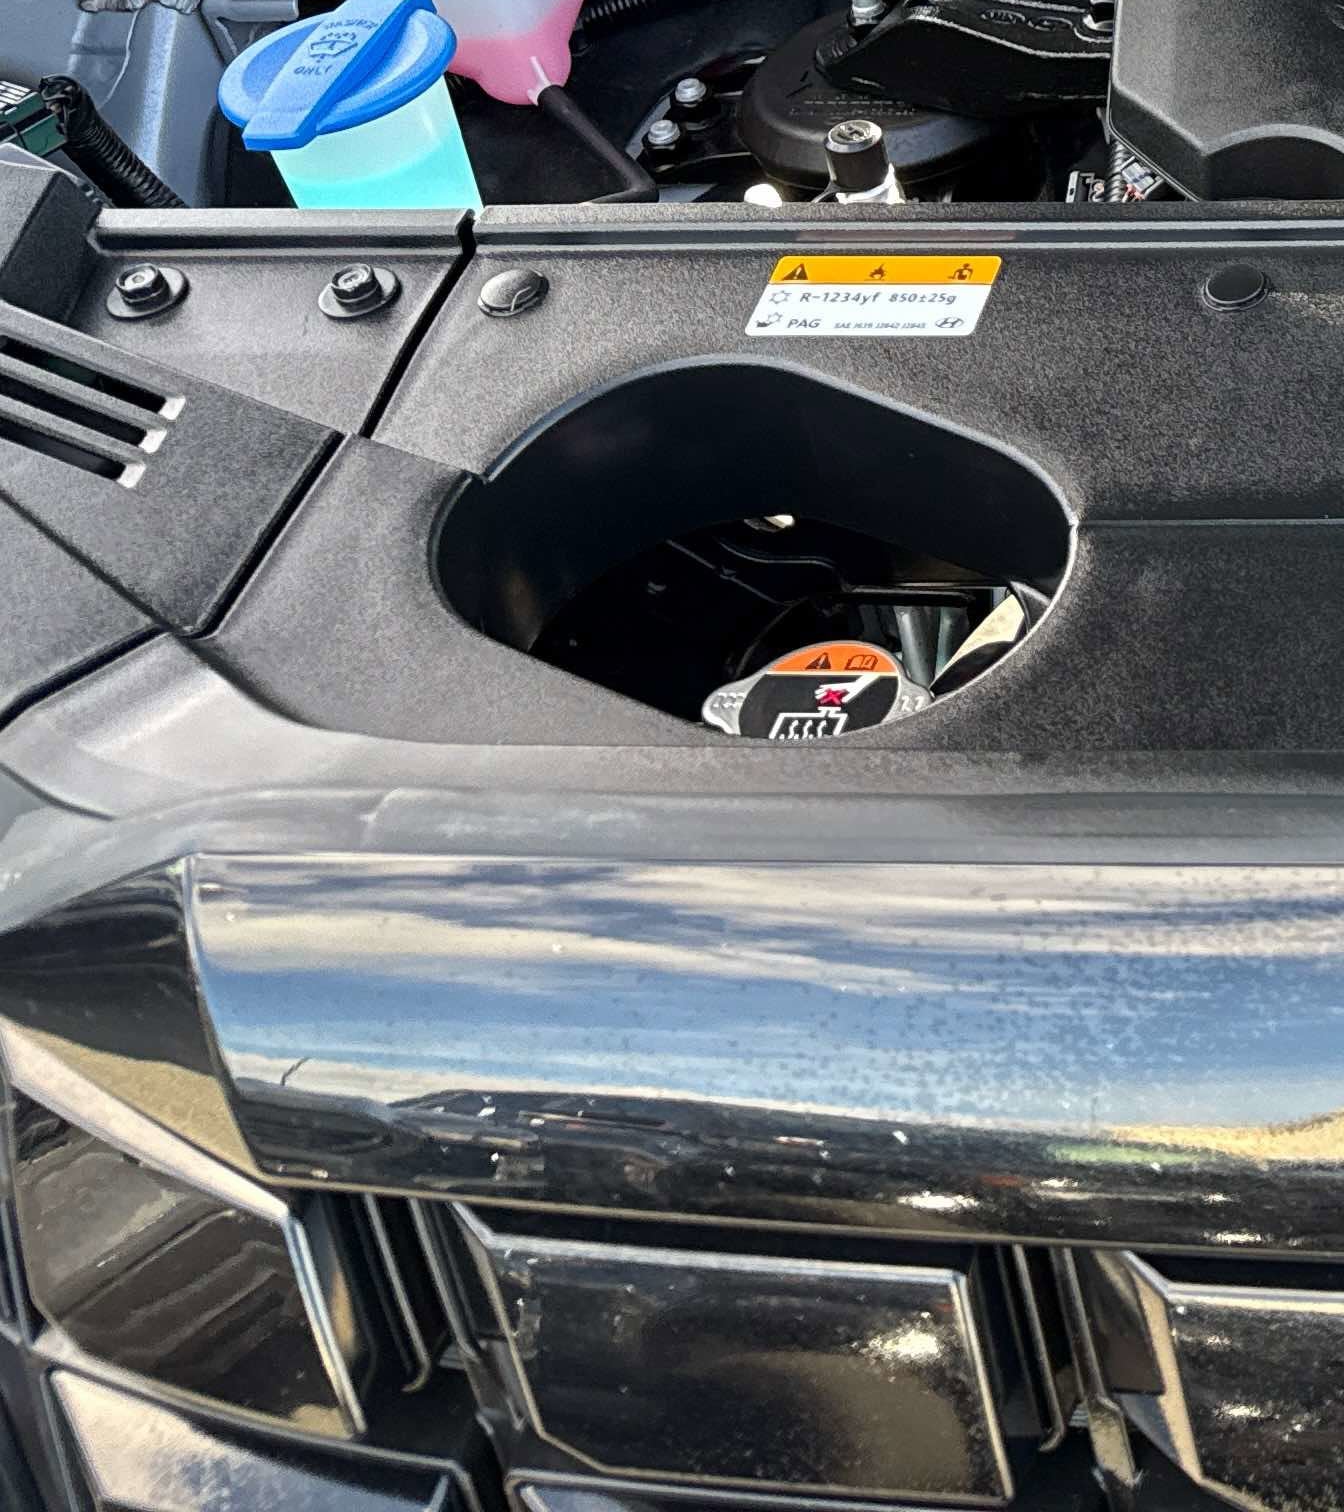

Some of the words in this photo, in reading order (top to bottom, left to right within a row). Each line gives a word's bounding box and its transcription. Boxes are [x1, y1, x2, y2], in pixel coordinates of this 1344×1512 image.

[293, 64, 333, 76] ONLY
[799, 291, 882, 306] R-1234yf
[888, 292, 957, 305] 850±25g
[786, 318, 821, 329] PAG
